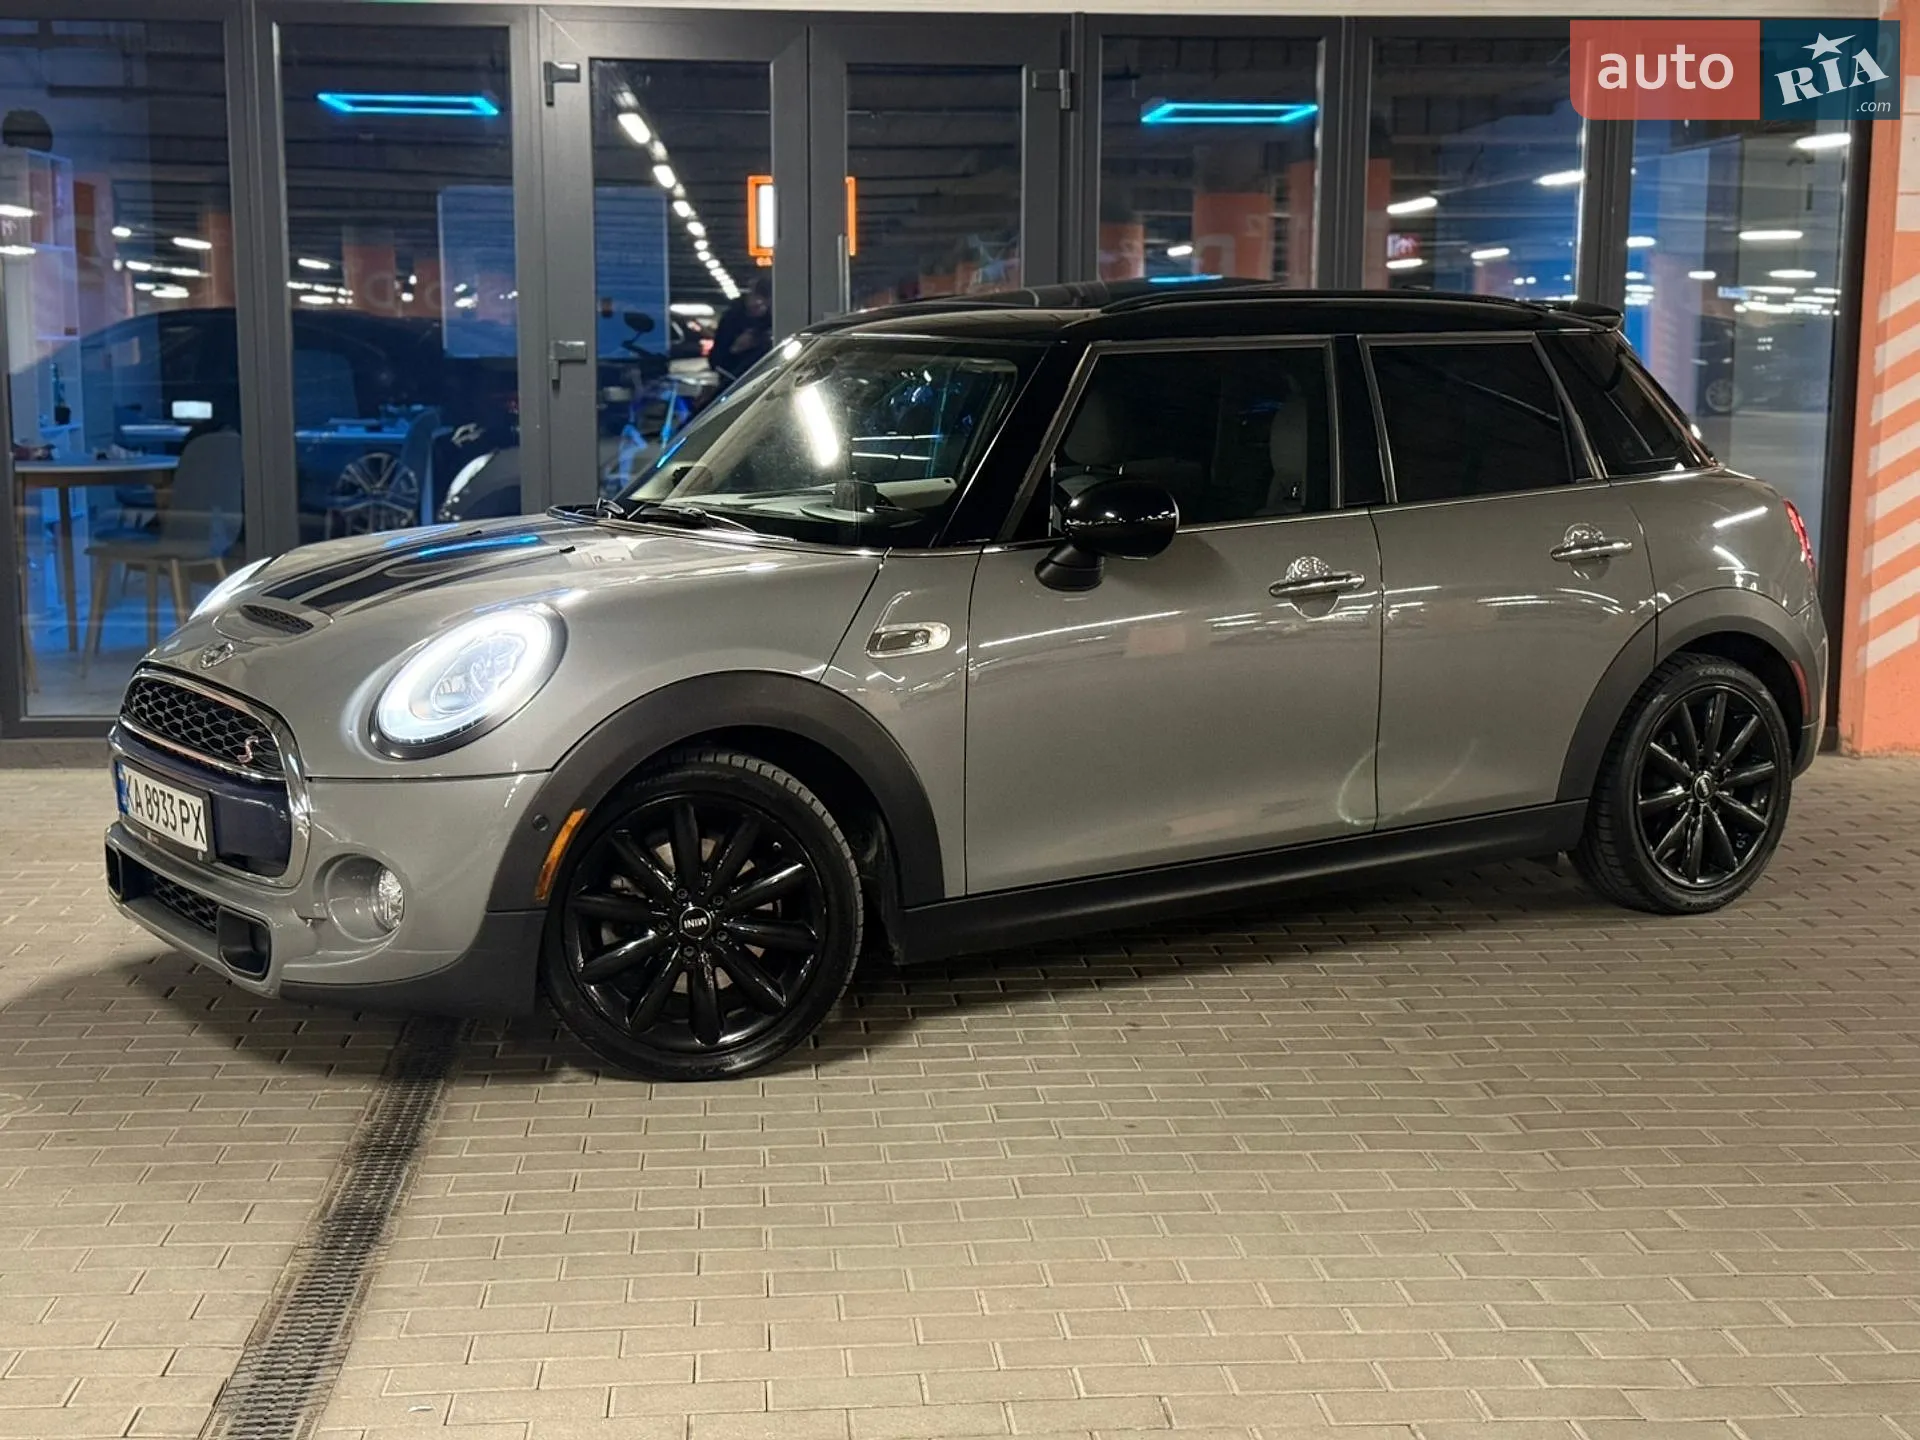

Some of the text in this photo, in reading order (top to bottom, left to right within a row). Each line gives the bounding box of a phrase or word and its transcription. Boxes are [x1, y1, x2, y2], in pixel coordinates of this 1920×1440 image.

[122, 772, 205, 844] KA 8933 PX
[683, 917, 707, 929] MINI
